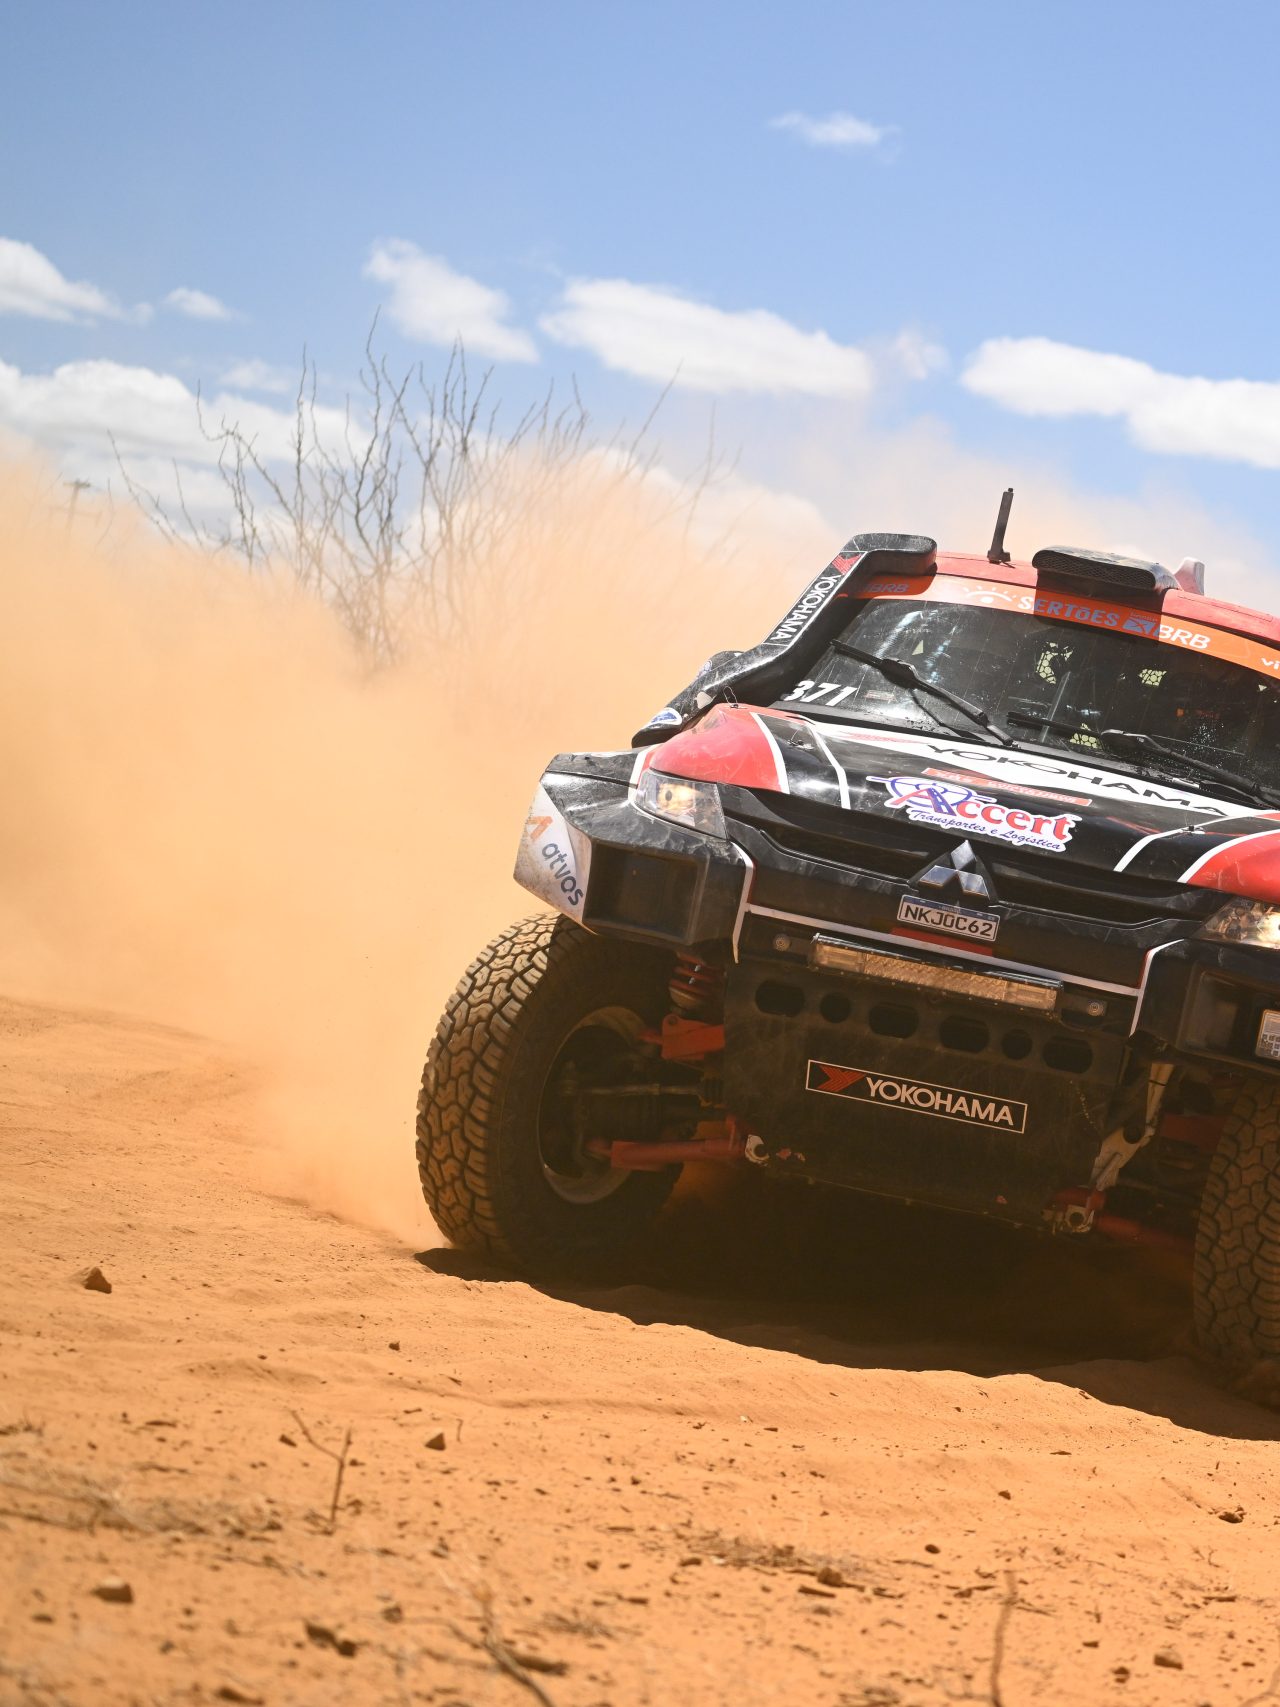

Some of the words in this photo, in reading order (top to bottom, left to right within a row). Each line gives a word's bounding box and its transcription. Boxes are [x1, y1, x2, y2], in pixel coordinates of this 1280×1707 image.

[769, 574, 841, 641] YOKOHAMA
[1154, 623, 1211, 650] BRB
[783, 680, 857, 707] 371
[926, 744, 1229, 817] YOKOHAMA
[890, 787, 1072, 841] Accert
[911, 809, 986, 833] Transportes
[541, 842, 584, 907] atvos
[866, 1077, 1015, 1126] YOKOHAMA
